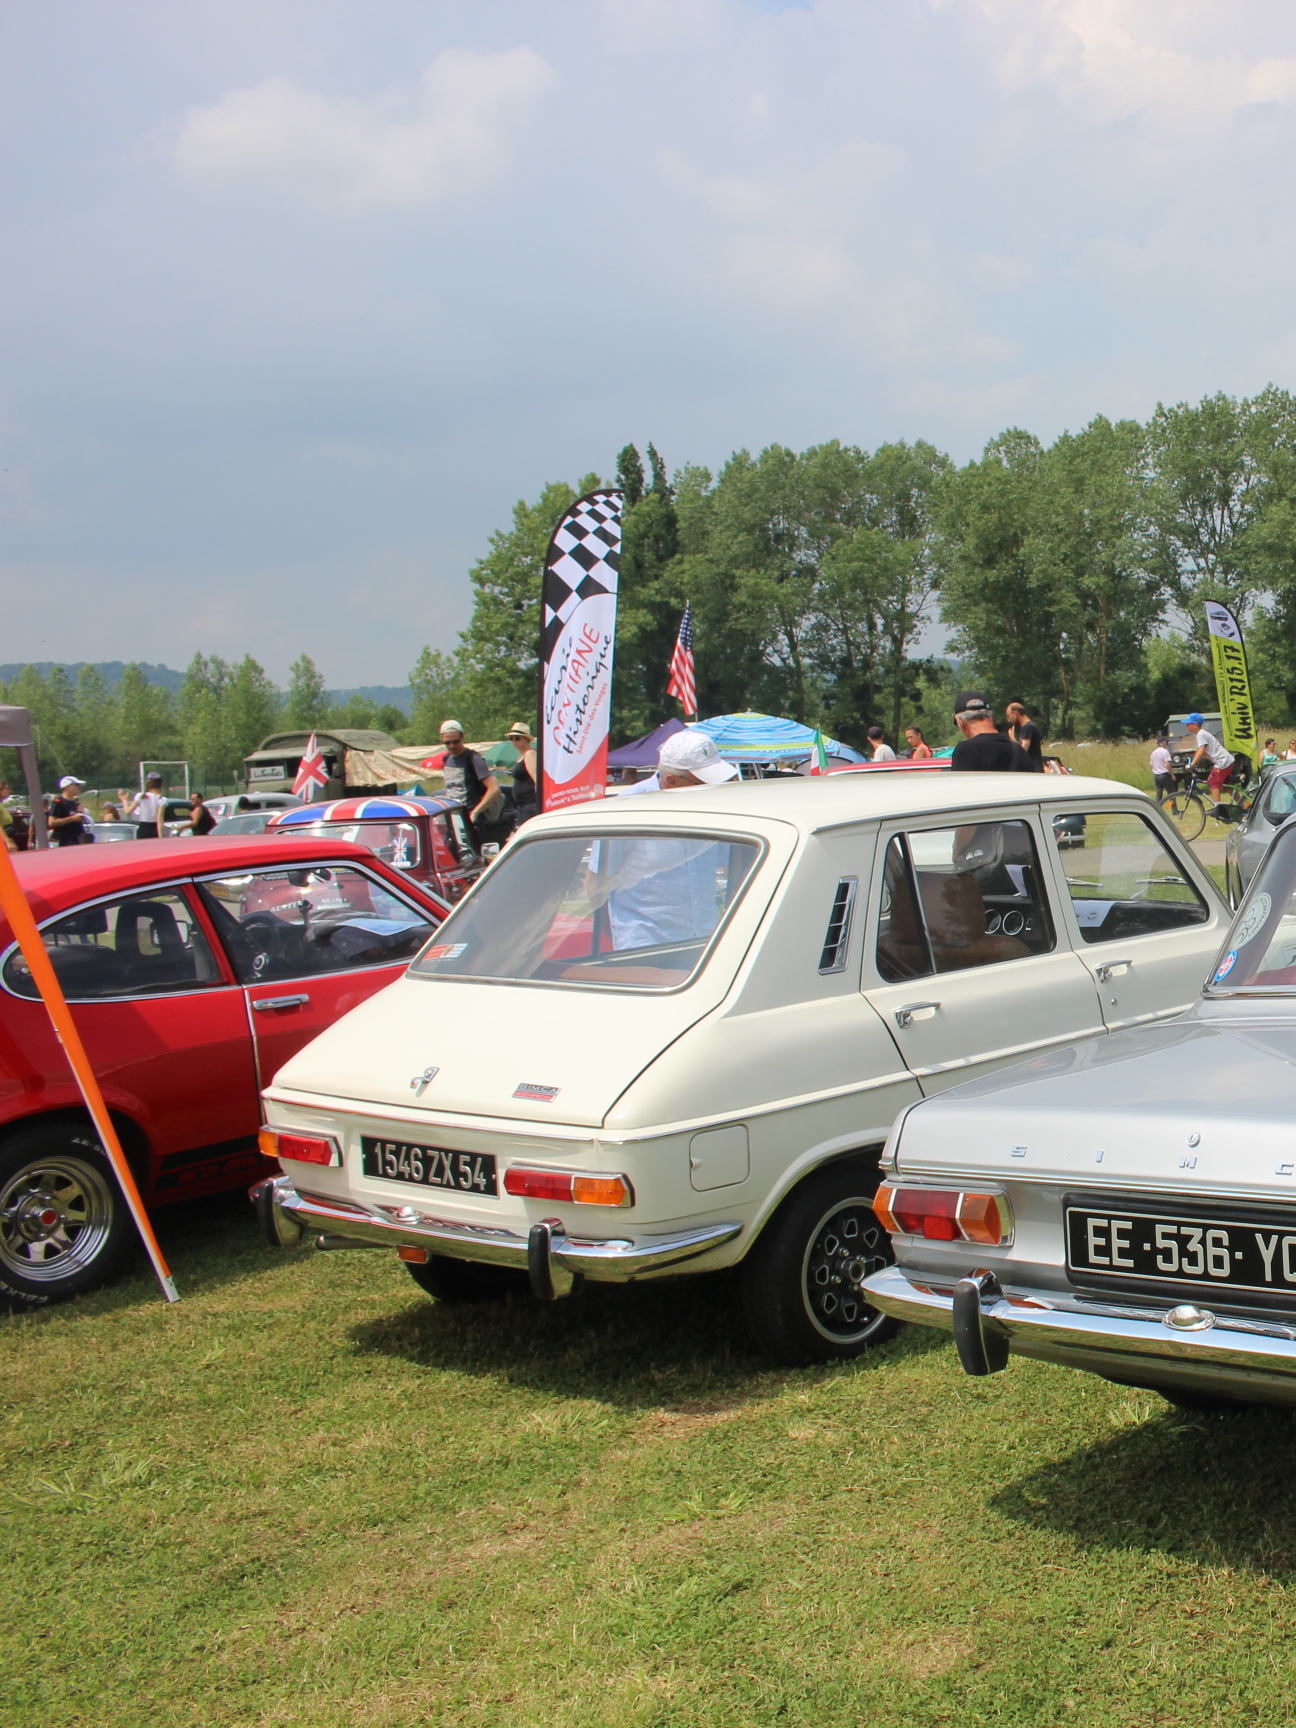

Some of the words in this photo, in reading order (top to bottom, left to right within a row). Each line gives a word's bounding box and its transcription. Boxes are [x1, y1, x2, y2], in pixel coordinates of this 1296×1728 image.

[563, 634, 612, 755] Historique
[577, 682, 609, 755] Saint-Dié-des-Vosges
[1223, 644, 1254, 740] Univ'R15.17
[519, 1083, 556, 1093] SIMCA
[374, 1142, 424, 1181] 1546
[426, 1149, 456, 1186] ZX
[458, 1154, 487, 1191] 54
